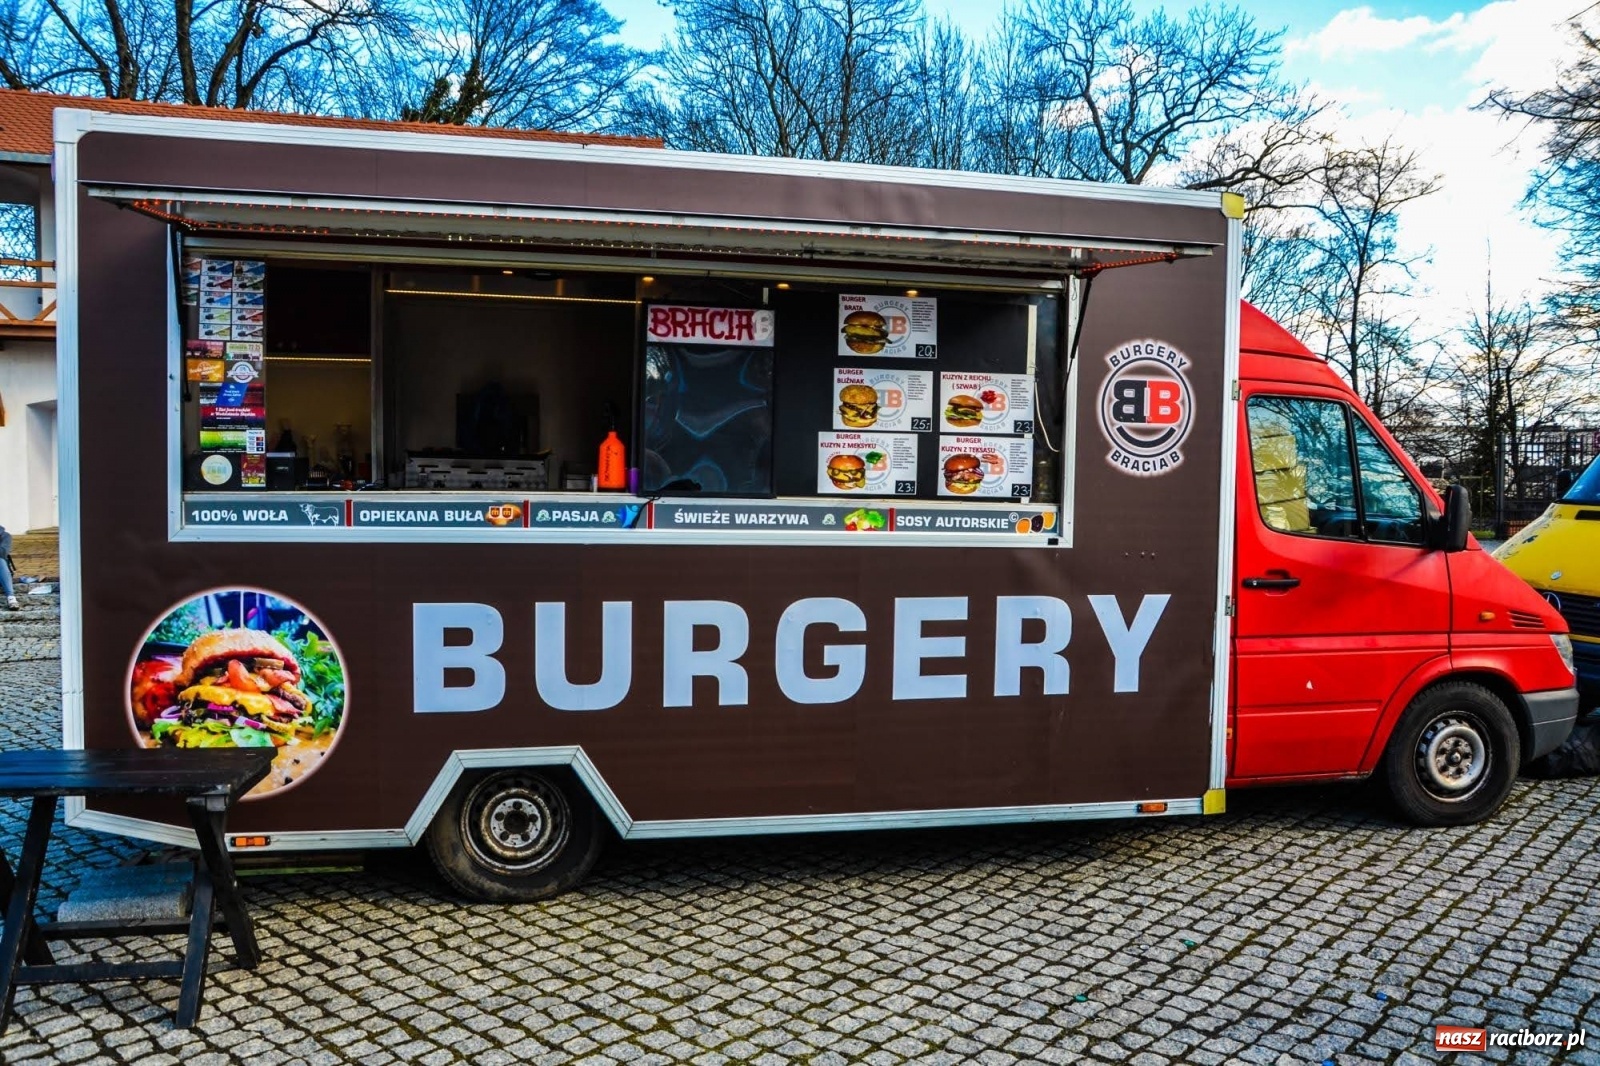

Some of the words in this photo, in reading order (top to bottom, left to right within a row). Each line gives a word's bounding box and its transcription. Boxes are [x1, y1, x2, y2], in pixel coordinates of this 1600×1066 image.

[841, 295, 866, 303] BURGER
[1109, 343, 1187, 368] BURGERY
[1110, 450, 1180, 472] BRACIAB
[191, 509, 238, 522] 100%
[242, 509, 289, 522] WOŁA
[359, 509, 439, 522] OPIEKANA
[444, 509, 484, 522] BUŁA
[552, 510, 599, 522] PASJA
[674, 508, 730, 525] ŚWIEŻE
[735, 513, 809, 525] WARZYWA
[896, 515, 932, 527] SOSY
[412, 594, 1171, 713] BURGERY
